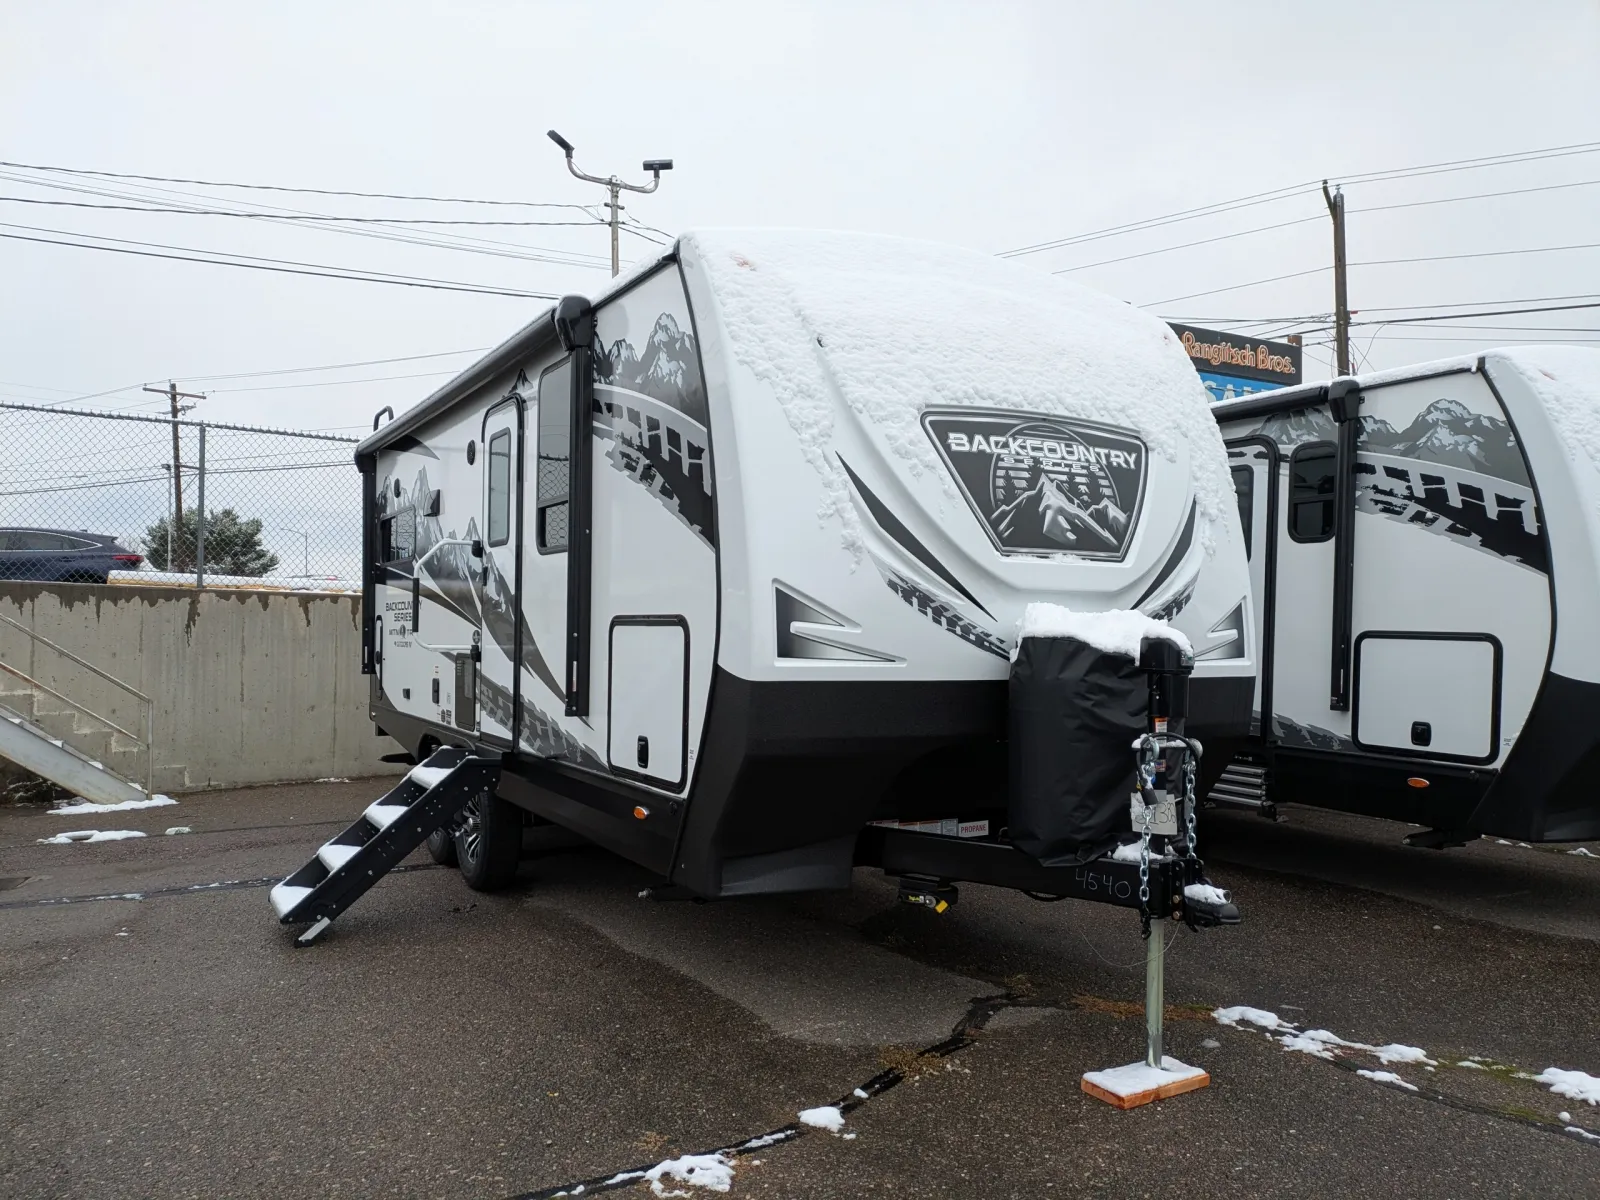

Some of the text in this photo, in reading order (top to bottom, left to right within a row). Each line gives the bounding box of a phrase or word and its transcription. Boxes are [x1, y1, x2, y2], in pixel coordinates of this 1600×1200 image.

[1182, 331, 1296, 374] Rangitsch Bros.
[947, 431, 1137, 470] BACKCOUNTRY
[1003, 456, 1100, 472] SERIES
[385, 600, 423, 612] BACKCOUNY
[393, 612, 413, 622] SERIES
[960, 823, 987, 834] PROPANE
[1075, 868, 1131, 899] 4540
